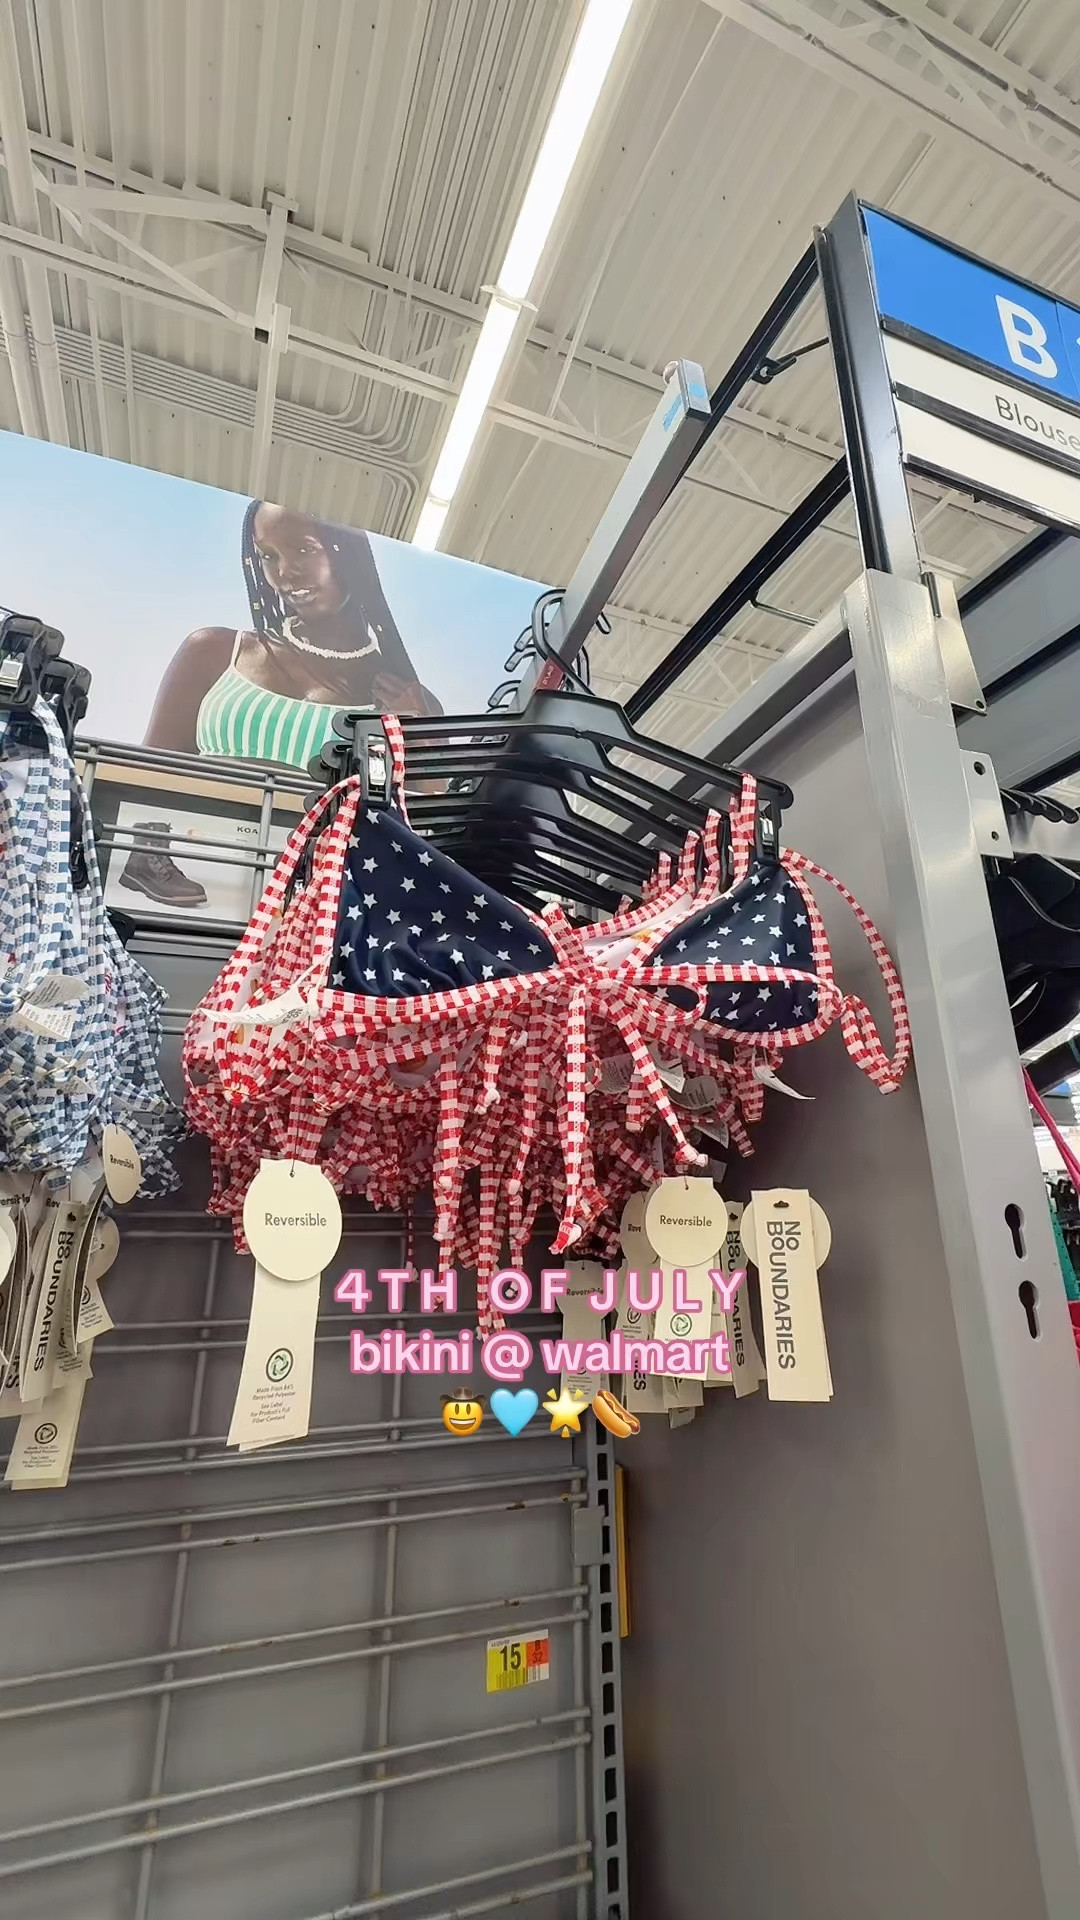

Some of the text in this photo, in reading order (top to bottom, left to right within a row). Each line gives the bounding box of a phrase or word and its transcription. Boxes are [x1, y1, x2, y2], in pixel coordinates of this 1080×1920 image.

[995, 294, 1058, 379] B
[995, 394, 1080, 451] Blouse
[264, 1212, 327, 1226] Reversible
[660, 1214, 712, 1227] Reversible
[784, 1221, 801, 1251] NO
[766, 1221, 796, 1369] BOUNDARIES
[500, 1643, 521, 1671] 15
